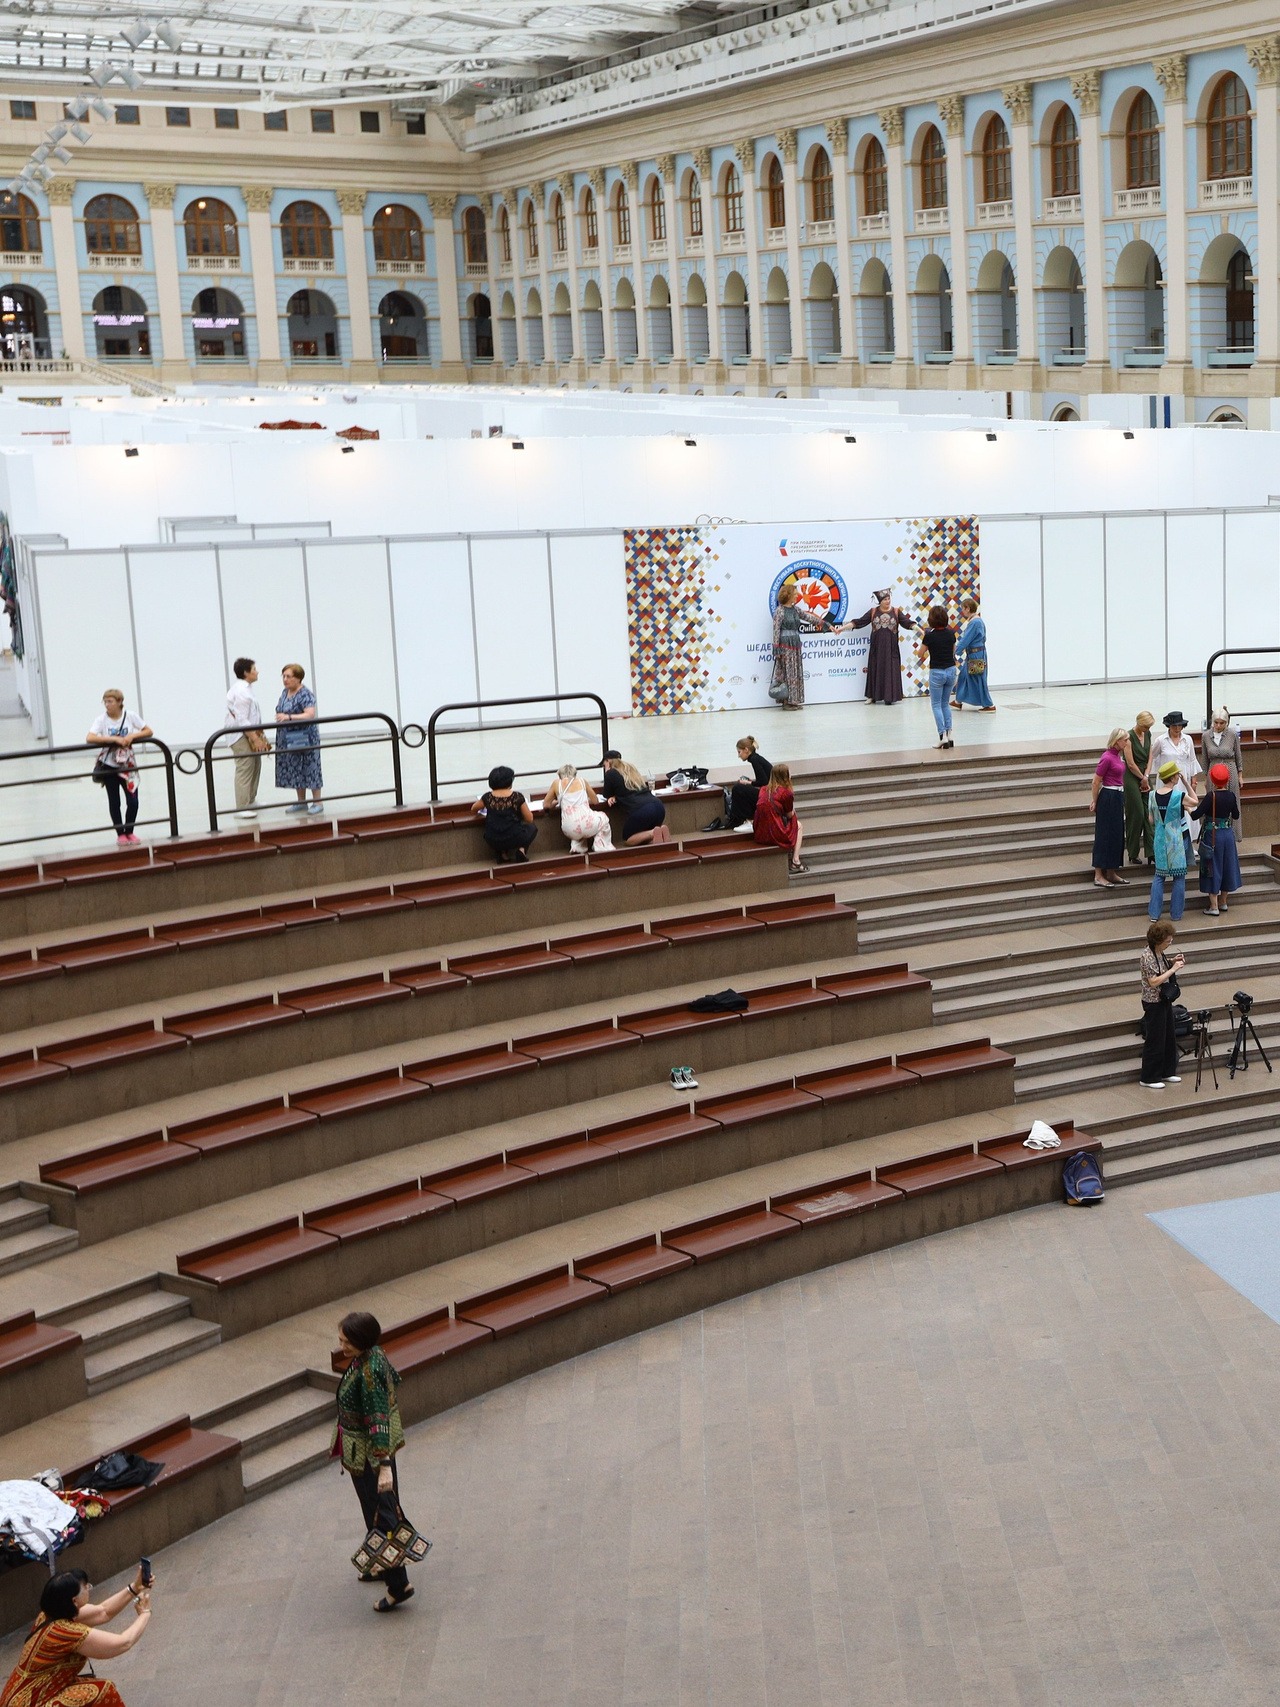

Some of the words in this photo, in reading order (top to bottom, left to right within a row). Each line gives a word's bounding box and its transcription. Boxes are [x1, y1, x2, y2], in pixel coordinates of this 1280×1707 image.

[794, 561, 825, 569] ЛОСКУТНОГО
[847, 637, 871, 645] ШИТЬ
[801, 648, 843, 660] ОСТИНЫЙ
[844, 648, 867, 658] ДВОР
